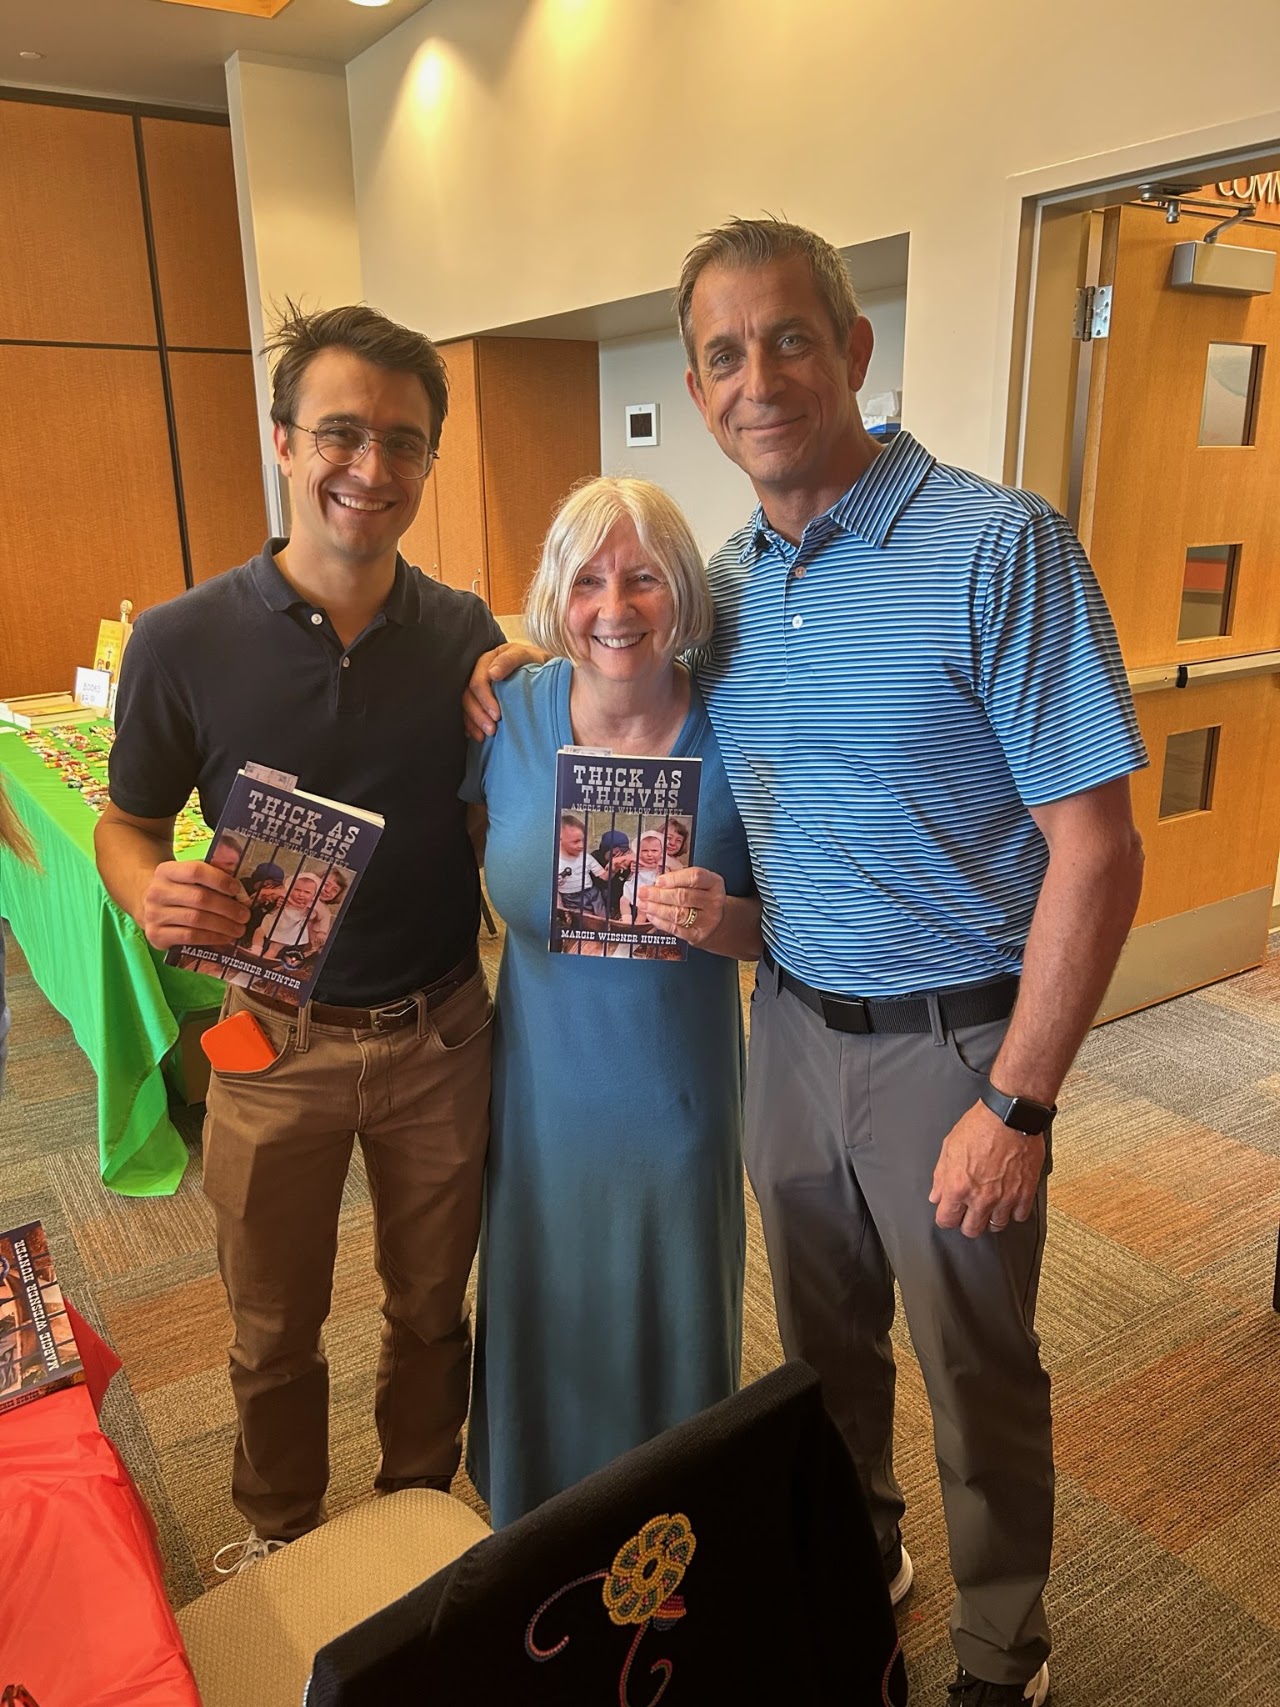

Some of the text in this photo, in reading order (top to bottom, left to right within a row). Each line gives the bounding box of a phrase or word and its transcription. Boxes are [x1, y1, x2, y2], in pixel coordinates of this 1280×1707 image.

[573, 765, 682, 789] THICK AS
[581, 784, 679, 808] THIEVES
[248, 789, 360, 844] THICK AS
[571, 803, 683, 816] ANGELS ON WILLOW STREET
[250, 811, 351, 860] THIEVES
[283, 840, 318, 858] WILLOW
[561, 930, 677, 945] MARGIE WIESNER HUNTER
[181, 945, 301, 989] MARGIE WIESNER HUNTER
[14, 1239, 60, 1371] MARGIE WIESNER HUNTER
